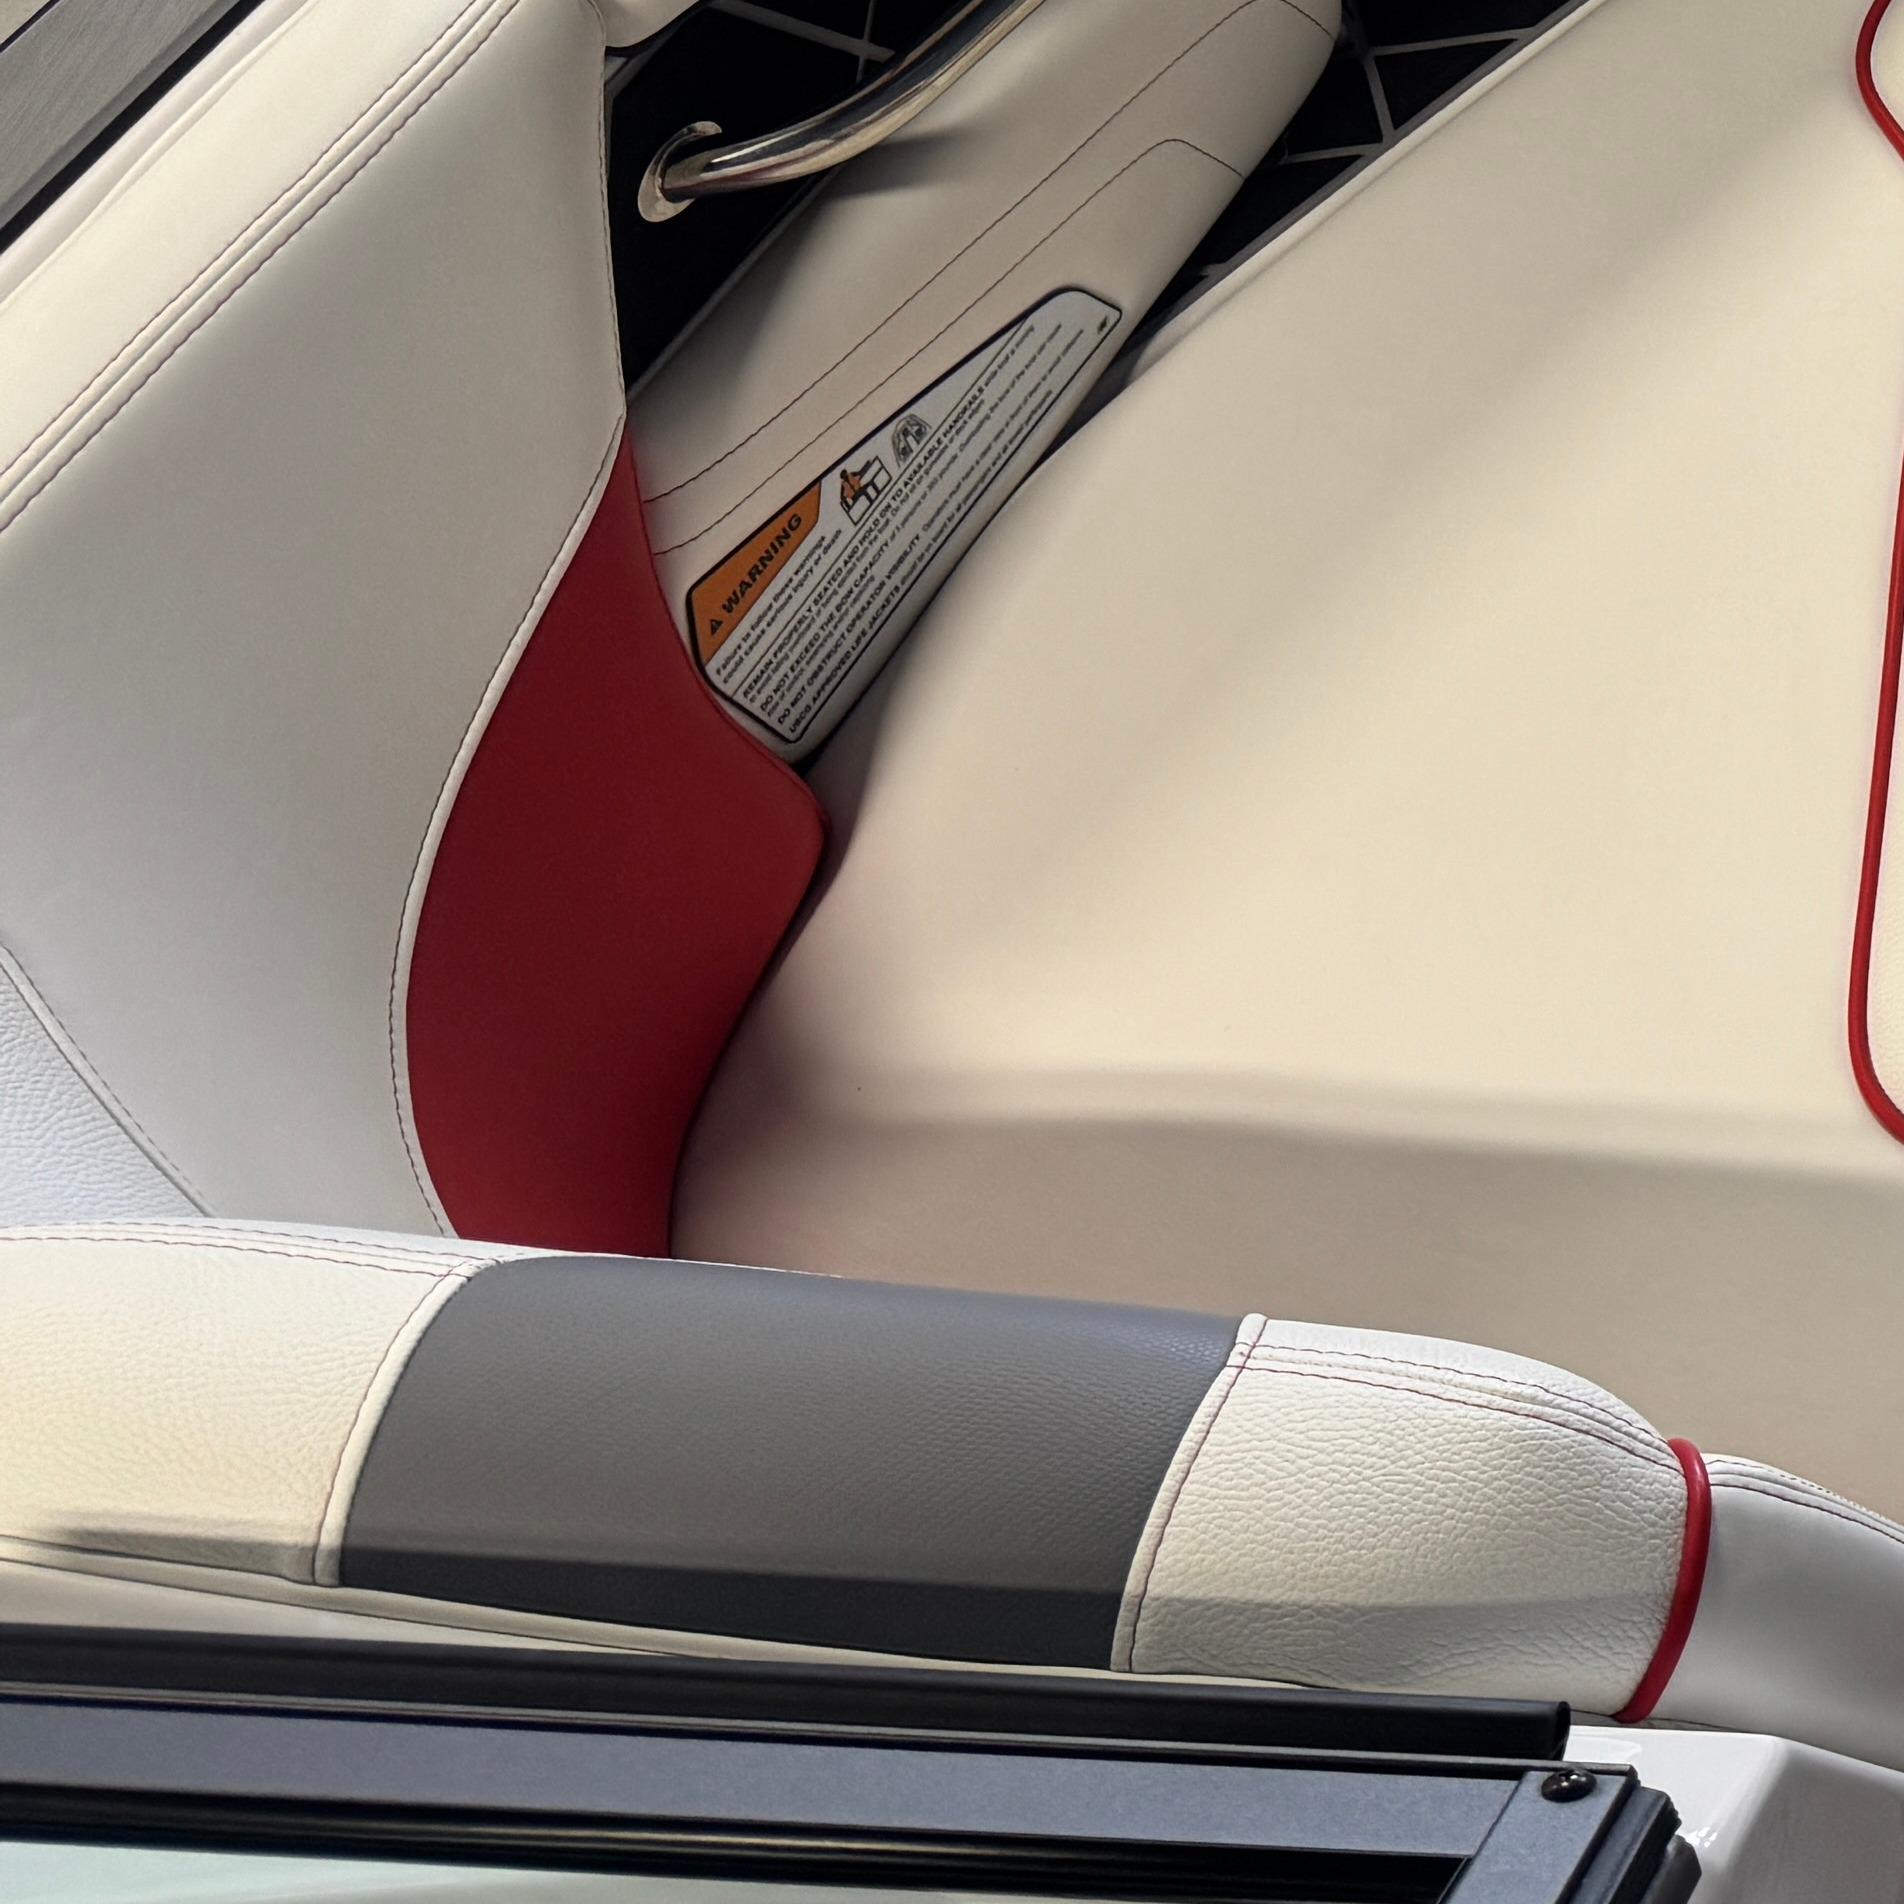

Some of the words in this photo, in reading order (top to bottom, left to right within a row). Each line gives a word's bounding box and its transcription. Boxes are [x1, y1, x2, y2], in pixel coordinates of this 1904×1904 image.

[721, 512, 802, 614] WARNING
[742, 657, 773, 698] REMAIN
[772, 605, 813, 658] PROPERLY
[812, 566, 843, 606] SEATED
[842, 544, 859, 567] AND
[858, 517, 880, 546] HOLD
[879, 502, 891, 519] ON
[892, 487, 903, 502] TO
[902, 436, 942, 489] AVAILABLE
[942, 385, 983, 438] HANDRAILS
[759, 693, 773, 711] DO
[772, 671, 790, 695] NOT
[788, 631, 820, 673] EXCEED
[819, 611, 835, 632] THE
[834, 586, 854, 613] BOW
[852, 539, 890, 588] CAPACITY
[777, 707, 791, 725] DO
[789, 684, 807, 708] NOT
[805, 632, 848, 687] OBSTRUCT
[844, 579, 887, 634] OPERATOR
[788, 703, 812, 733] USCG
[809, 649, 852, 704] APPROVED
[850, 628, 868, 651] LIFE
[866, 584, 900, 629] JACKETS
